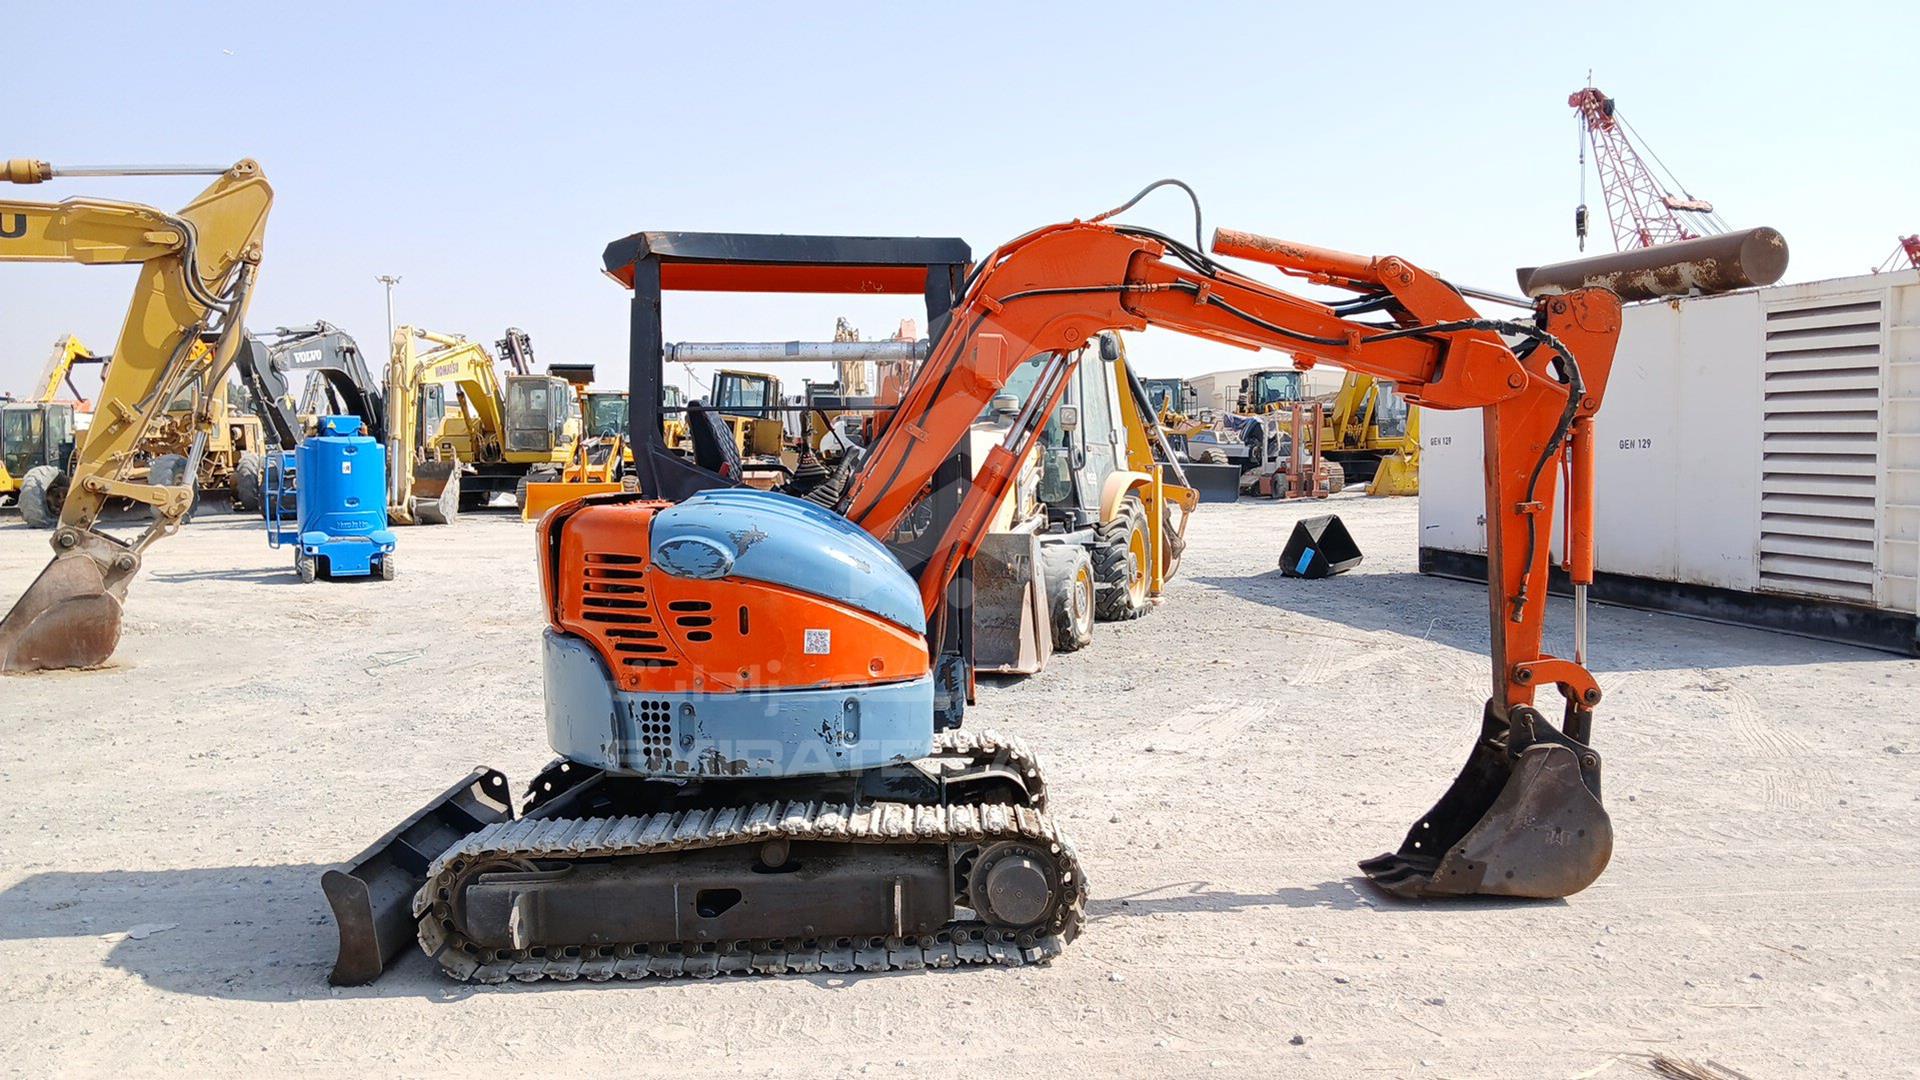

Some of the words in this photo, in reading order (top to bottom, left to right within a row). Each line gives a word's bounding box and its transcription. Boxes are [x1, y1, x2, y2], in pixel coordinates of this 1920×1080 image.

[293, 349, 322, 363] VOLVO
[1430, 437, 1441, 446] GEN
[1619, 439, 1635, 450] GEN
[1637, 438, 1652, 449] 129
